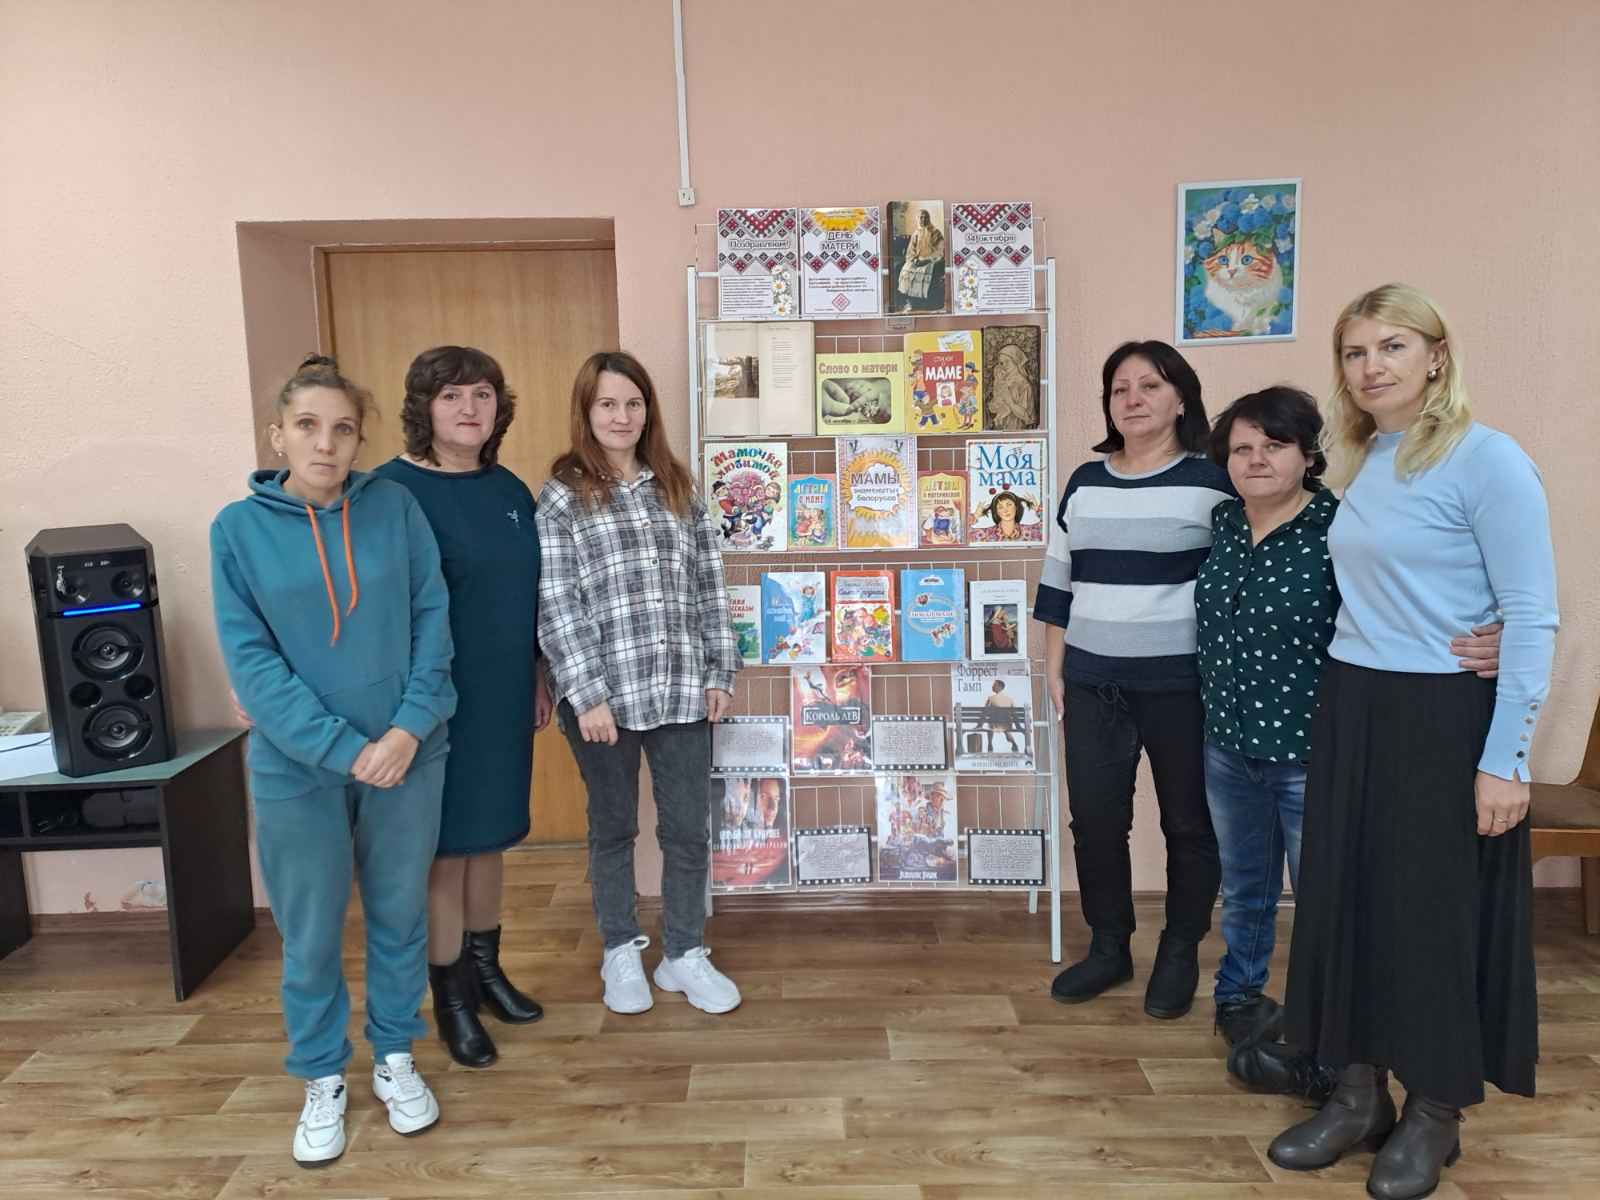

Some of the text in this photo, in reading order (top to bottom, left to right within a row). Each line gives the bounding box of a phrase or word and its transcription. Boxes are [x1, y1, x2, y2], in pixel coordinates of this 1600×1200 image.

[827, 231, 853, 241] ДЕНЬ
[979, 234, 1014, 244] октября
[729, 239, 790, 250] Поздравляем!
[821, 241, 859, 251] МАТЕРИ
[818, 362, 898, 375] Слово о матери
[925, 366, 962, 381] МАМЕ
[710, 447, 783, 469] Мамочке
[978, 445, 1033, 470] Моя
[715, 459, 780, 480] любимой
[851, 472, 900, 485] МАМЫ
[979, 471, 1037, 486] мама
[957, 663, 999, 681] Форрест
[957, 678, 982, 693] Гамп
[805, 711, 858, 722] КОРОЛЬ ЛЕВ
